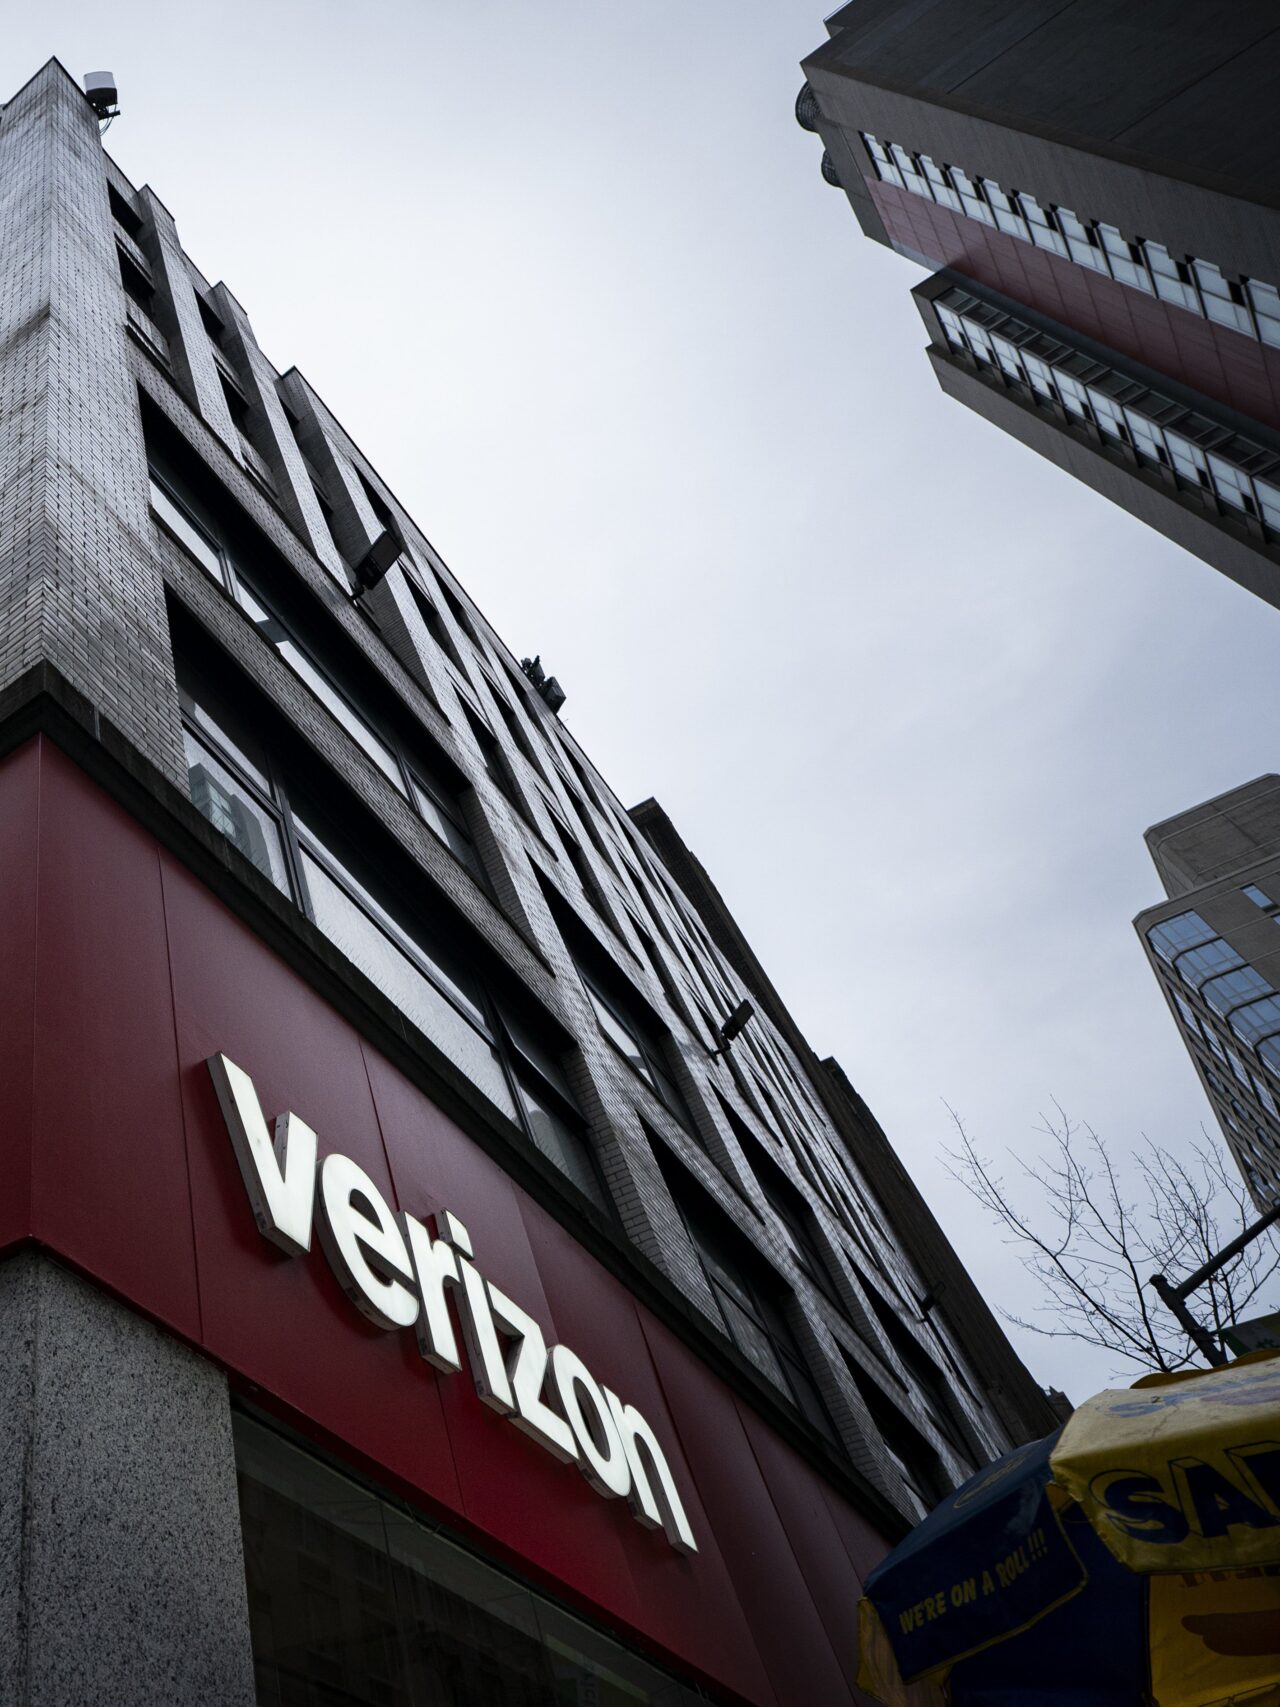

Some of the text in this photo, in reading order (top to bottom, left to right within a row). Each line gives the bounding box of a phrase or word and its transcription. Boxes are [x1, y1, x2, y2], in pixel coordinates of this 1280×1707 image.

[207, 1051, 698, 1554] verizon
[898, 1590, 948, 1635] WE'RE
[950, 1577, 977, 1608] ON
[981, 1570, 995, 1597] A
